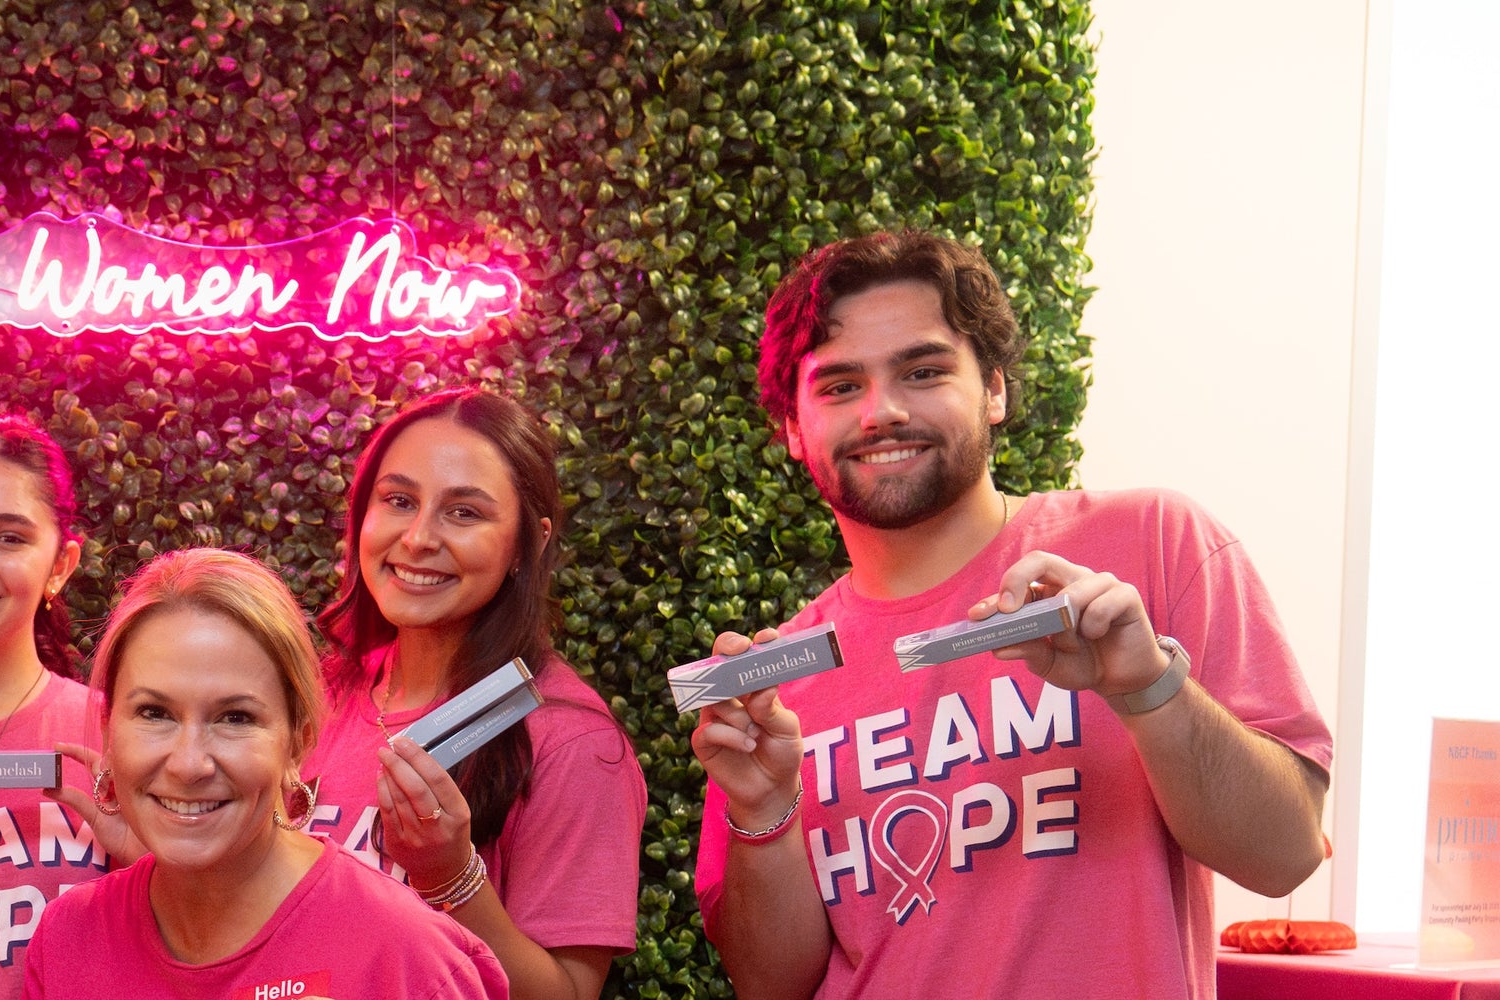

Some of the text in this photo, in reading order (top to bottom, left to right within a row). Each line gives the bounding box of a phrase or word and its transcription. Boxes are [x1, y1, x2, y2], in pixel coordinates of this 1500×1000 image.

[17, 221, 298, 322] Women
[326, 230, 507, 325] Now
[738, 647, 817, 686] primelash
[802, 675, 1082, 805] TEAM
[808, 766, 1082, 926] HOPE
